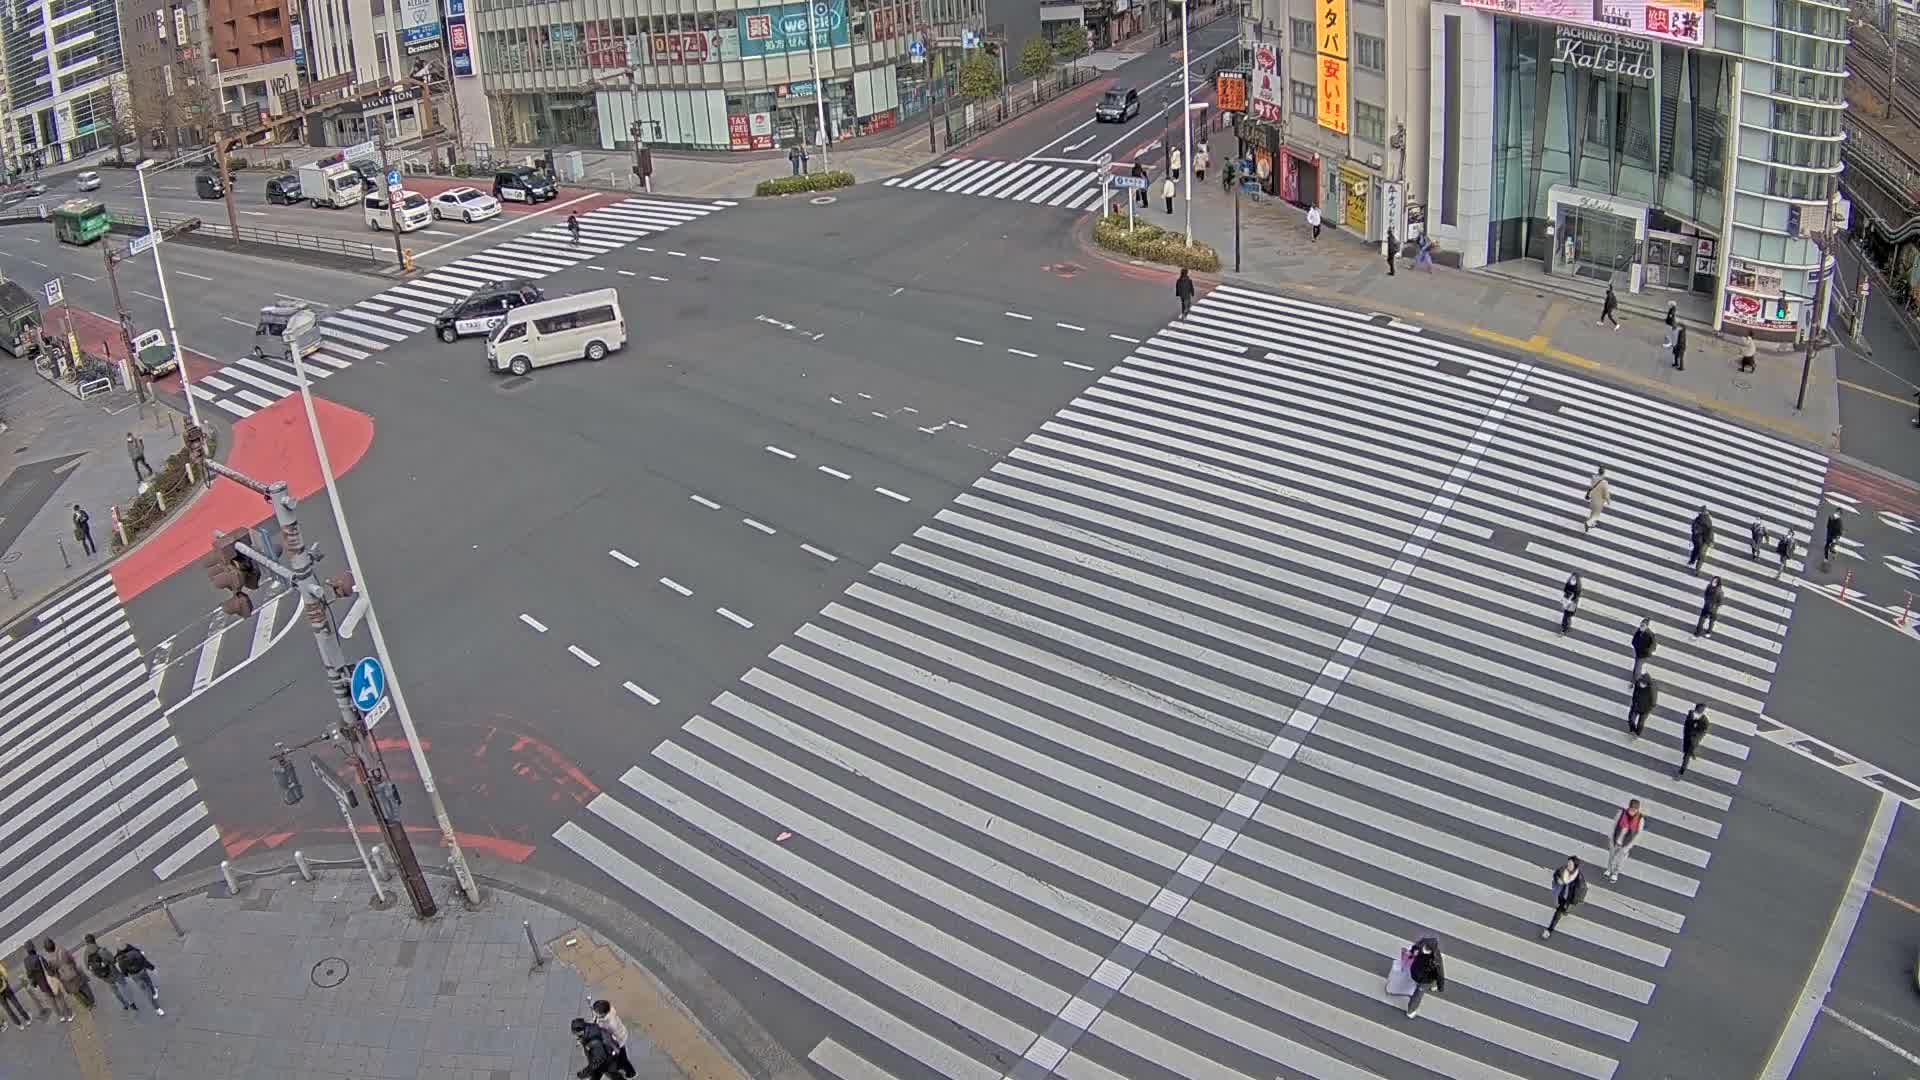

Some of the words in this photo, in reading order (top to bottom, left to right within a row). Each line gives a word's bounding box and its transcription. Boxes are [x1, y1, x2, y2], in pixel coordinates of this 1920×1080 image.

[1556, 26, 1613, 44] PACHINKO
[1624, 40, 1651, 53] SLOT
[1550, 38, 1656, 80] Kaleido
[731, 117, 746, 125] TAX
[731, 125, 748, 133] FREE
